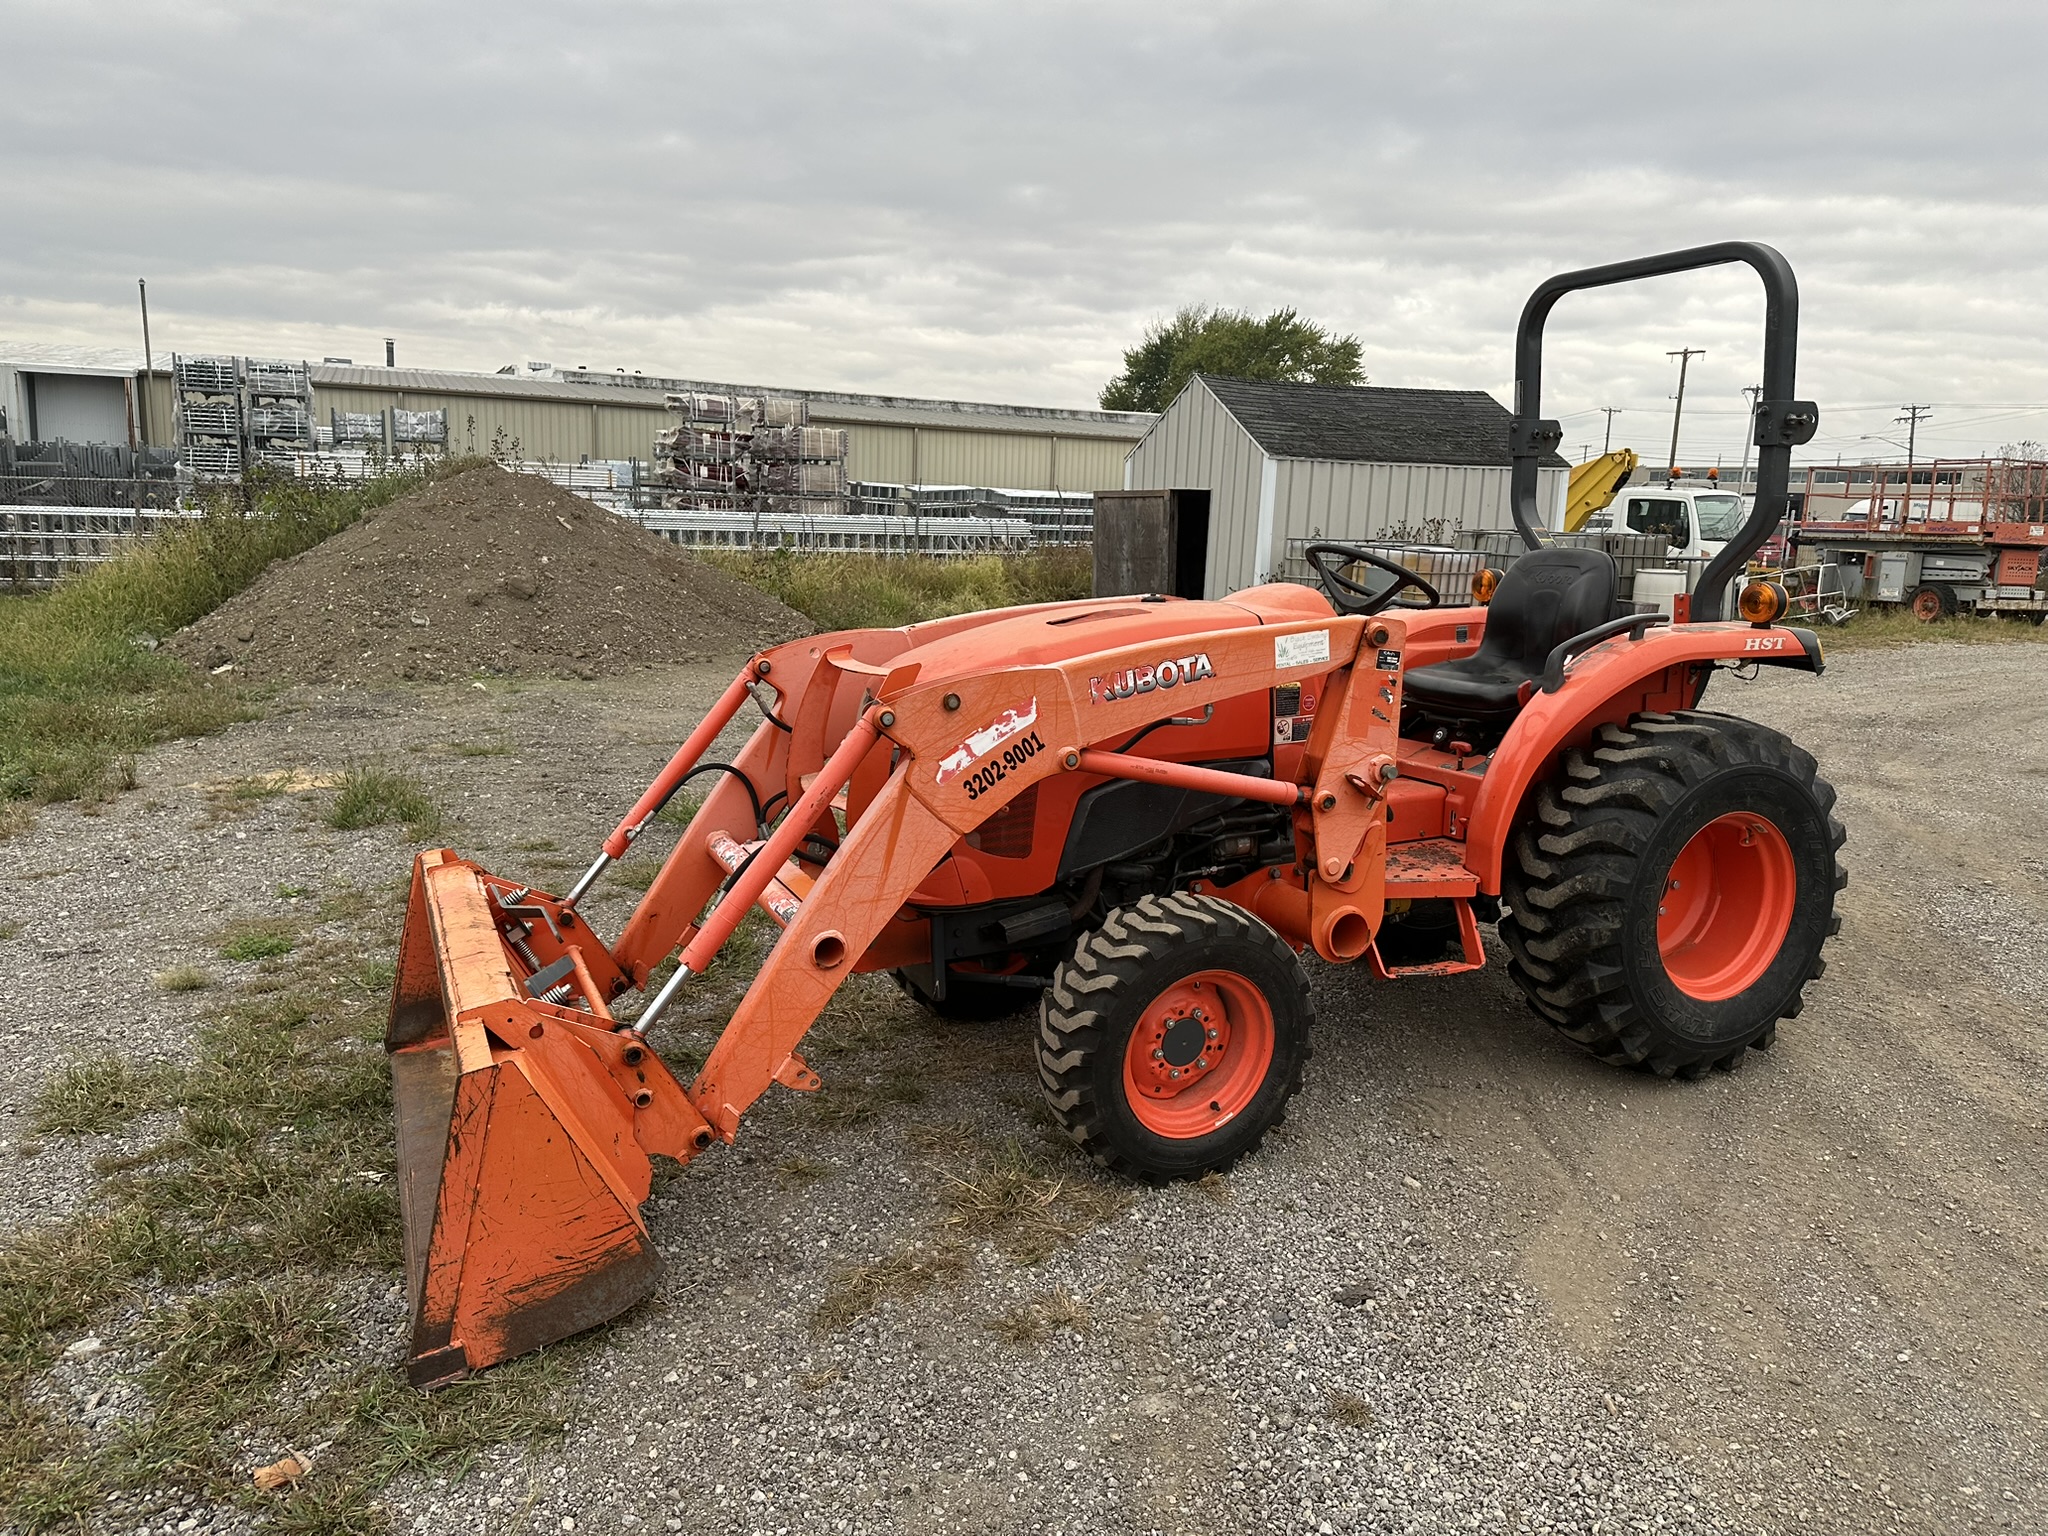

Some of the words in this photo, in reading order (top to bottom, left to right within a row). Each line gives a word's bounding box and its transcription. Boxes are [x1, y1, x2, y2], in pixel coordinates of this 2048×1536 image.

[1928, 525, 1959, 533] SKYJACK
[2007, 564, 2033, 573] SKYJACK
[1743, 637, 1786, 651] HST
[1088, 653, 1214, 705] KUBOTA
[963, 731, 1046, 801] 3202-9001
[1801, 817, 1827, 935] TITAN
[1647, 984, 1716, 1037] TRAC
